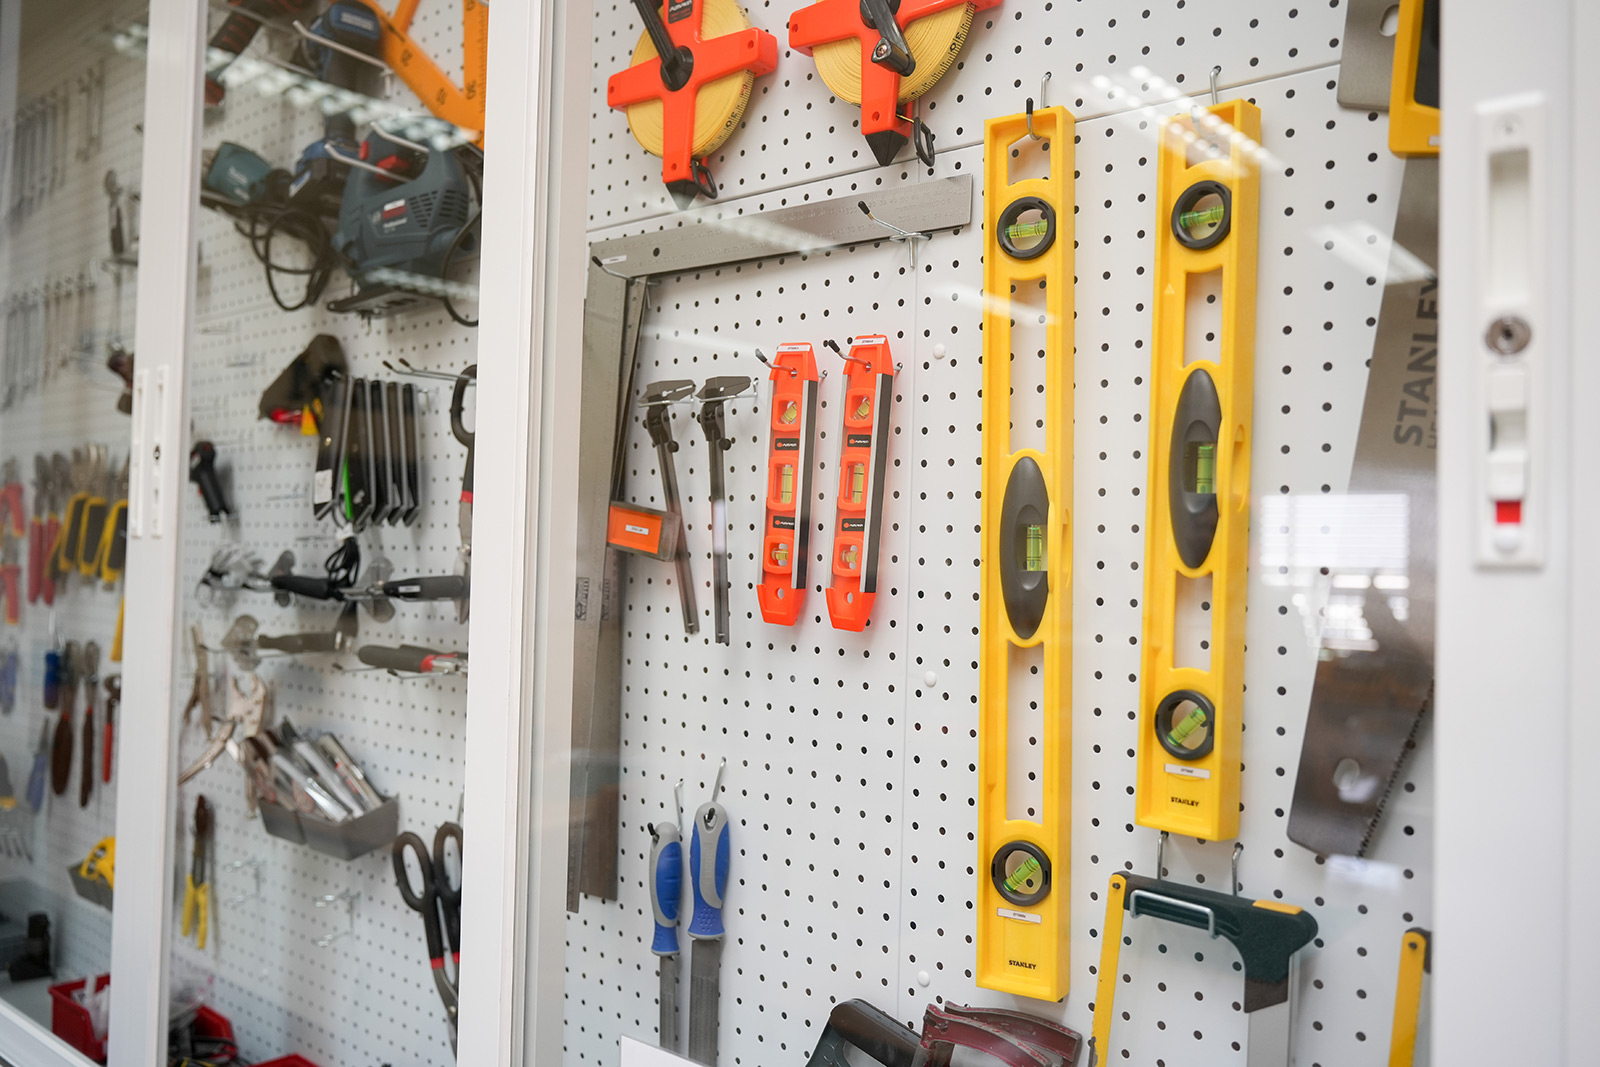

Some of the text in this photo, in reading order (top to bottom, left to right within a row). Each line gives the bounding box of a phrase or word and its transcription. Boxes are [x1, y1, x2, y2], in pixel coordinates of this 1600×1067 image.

[1393, 273, 1438, 447] STANLEY
[1170, 796, 1199, 807] STANLEY
[1008, 959, 1036, 970] STANLEY
